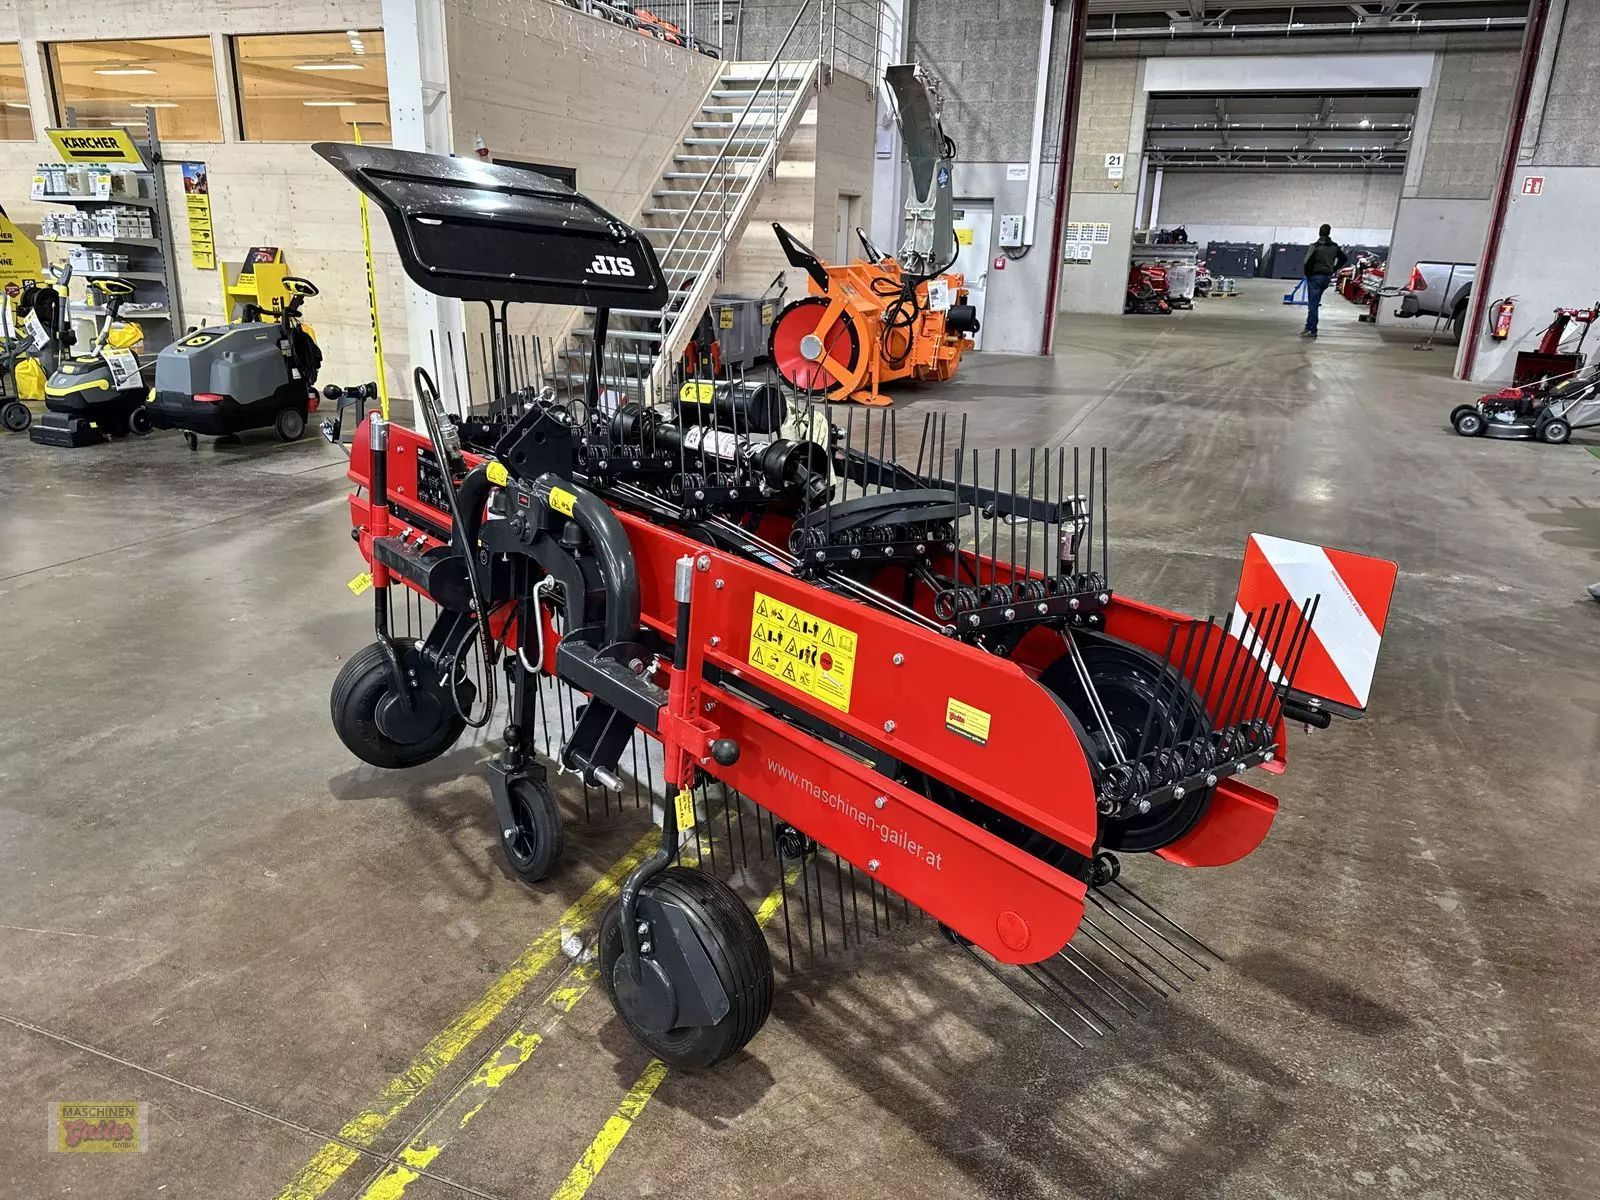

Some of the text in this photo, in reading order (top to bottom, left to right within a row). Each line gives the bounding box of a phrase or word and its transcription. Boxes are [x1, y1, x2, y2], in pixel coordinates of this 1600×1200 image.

[60, 137, 120, 149] KÄRCHER
[1108, 155, 1121, 165] 21
[591, 254, 636, 277] SIP
[767, 758, 943, 871] www.maschinen-gailer.at
